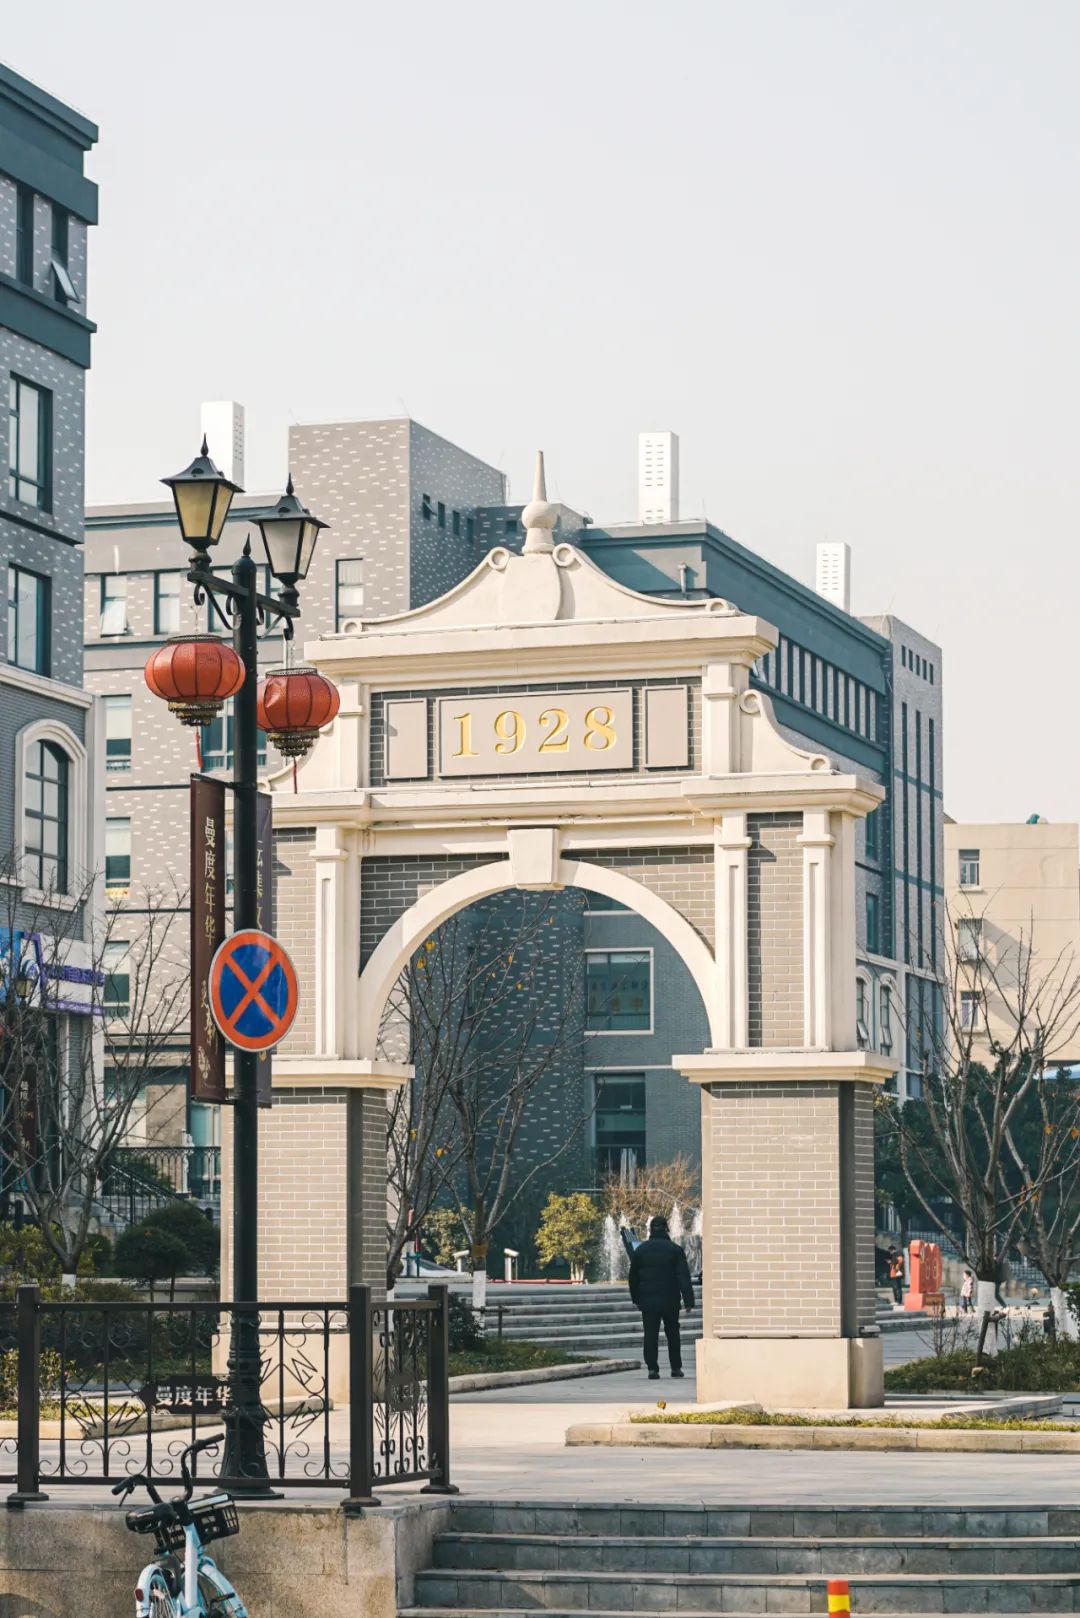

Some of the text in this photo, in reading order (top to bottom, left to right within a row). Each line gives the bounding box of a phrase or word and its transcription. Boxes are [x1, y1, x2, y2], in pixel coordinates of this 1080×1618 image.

[452, 706, 617, 757] 1928
[204, 816, 216, 946] 曼度年华
[155, 1385, 233, 1407] 曼度年华
